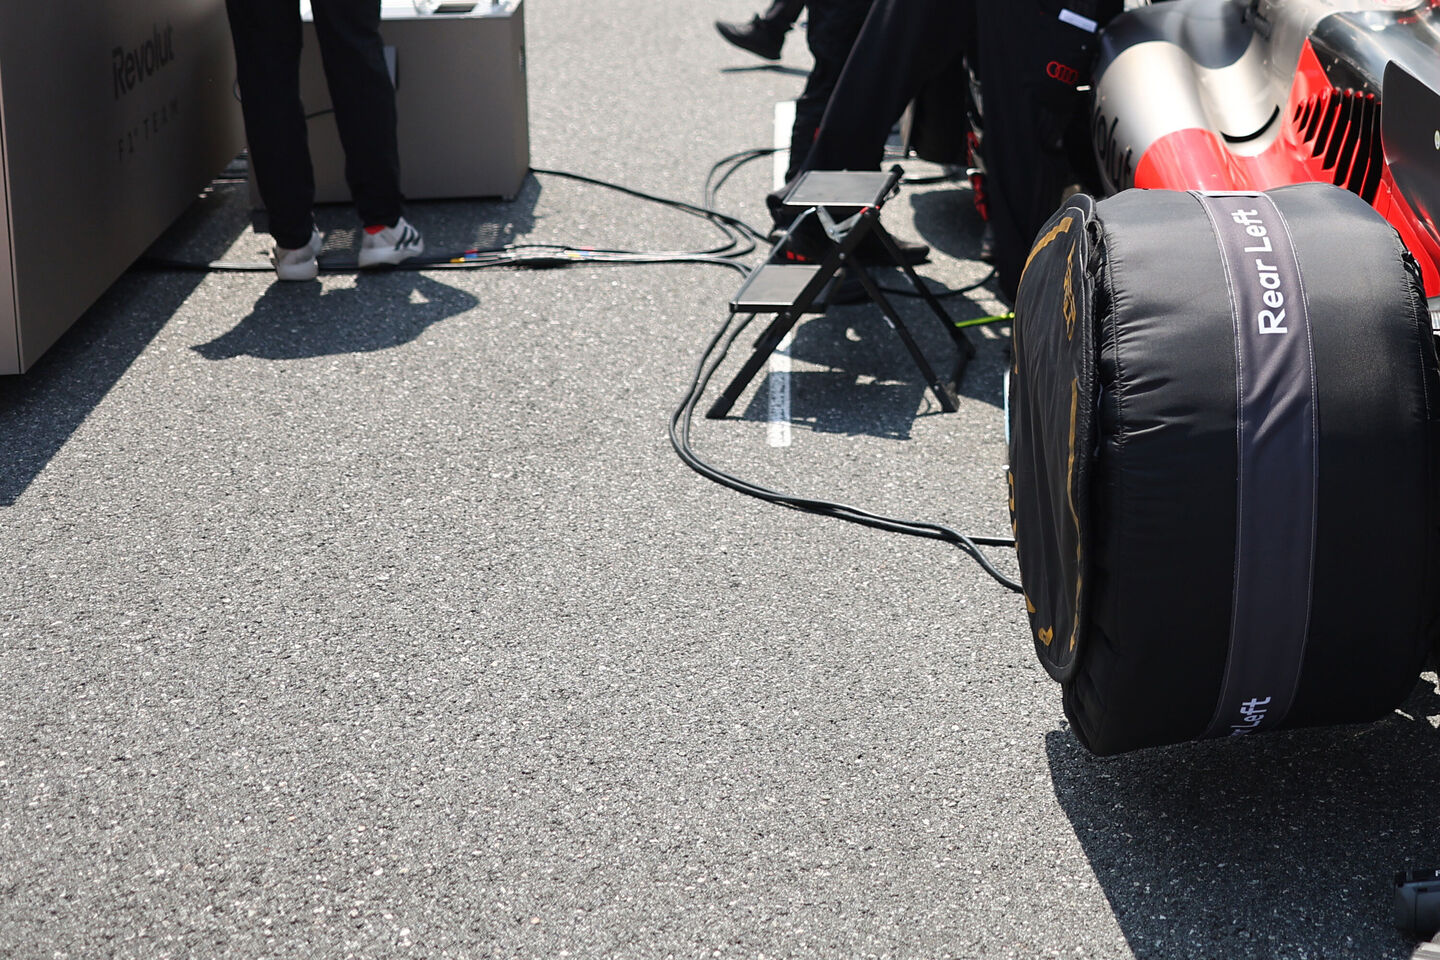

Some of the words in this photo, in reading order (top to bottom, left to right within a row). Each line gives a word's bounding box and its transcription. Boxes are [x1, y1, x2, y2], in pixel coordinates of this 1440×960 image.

[1231, 209, 1273, 253] Left
[1256, 258, 1288, 335] Rear
[1231, 696, 1272, 729] Left
